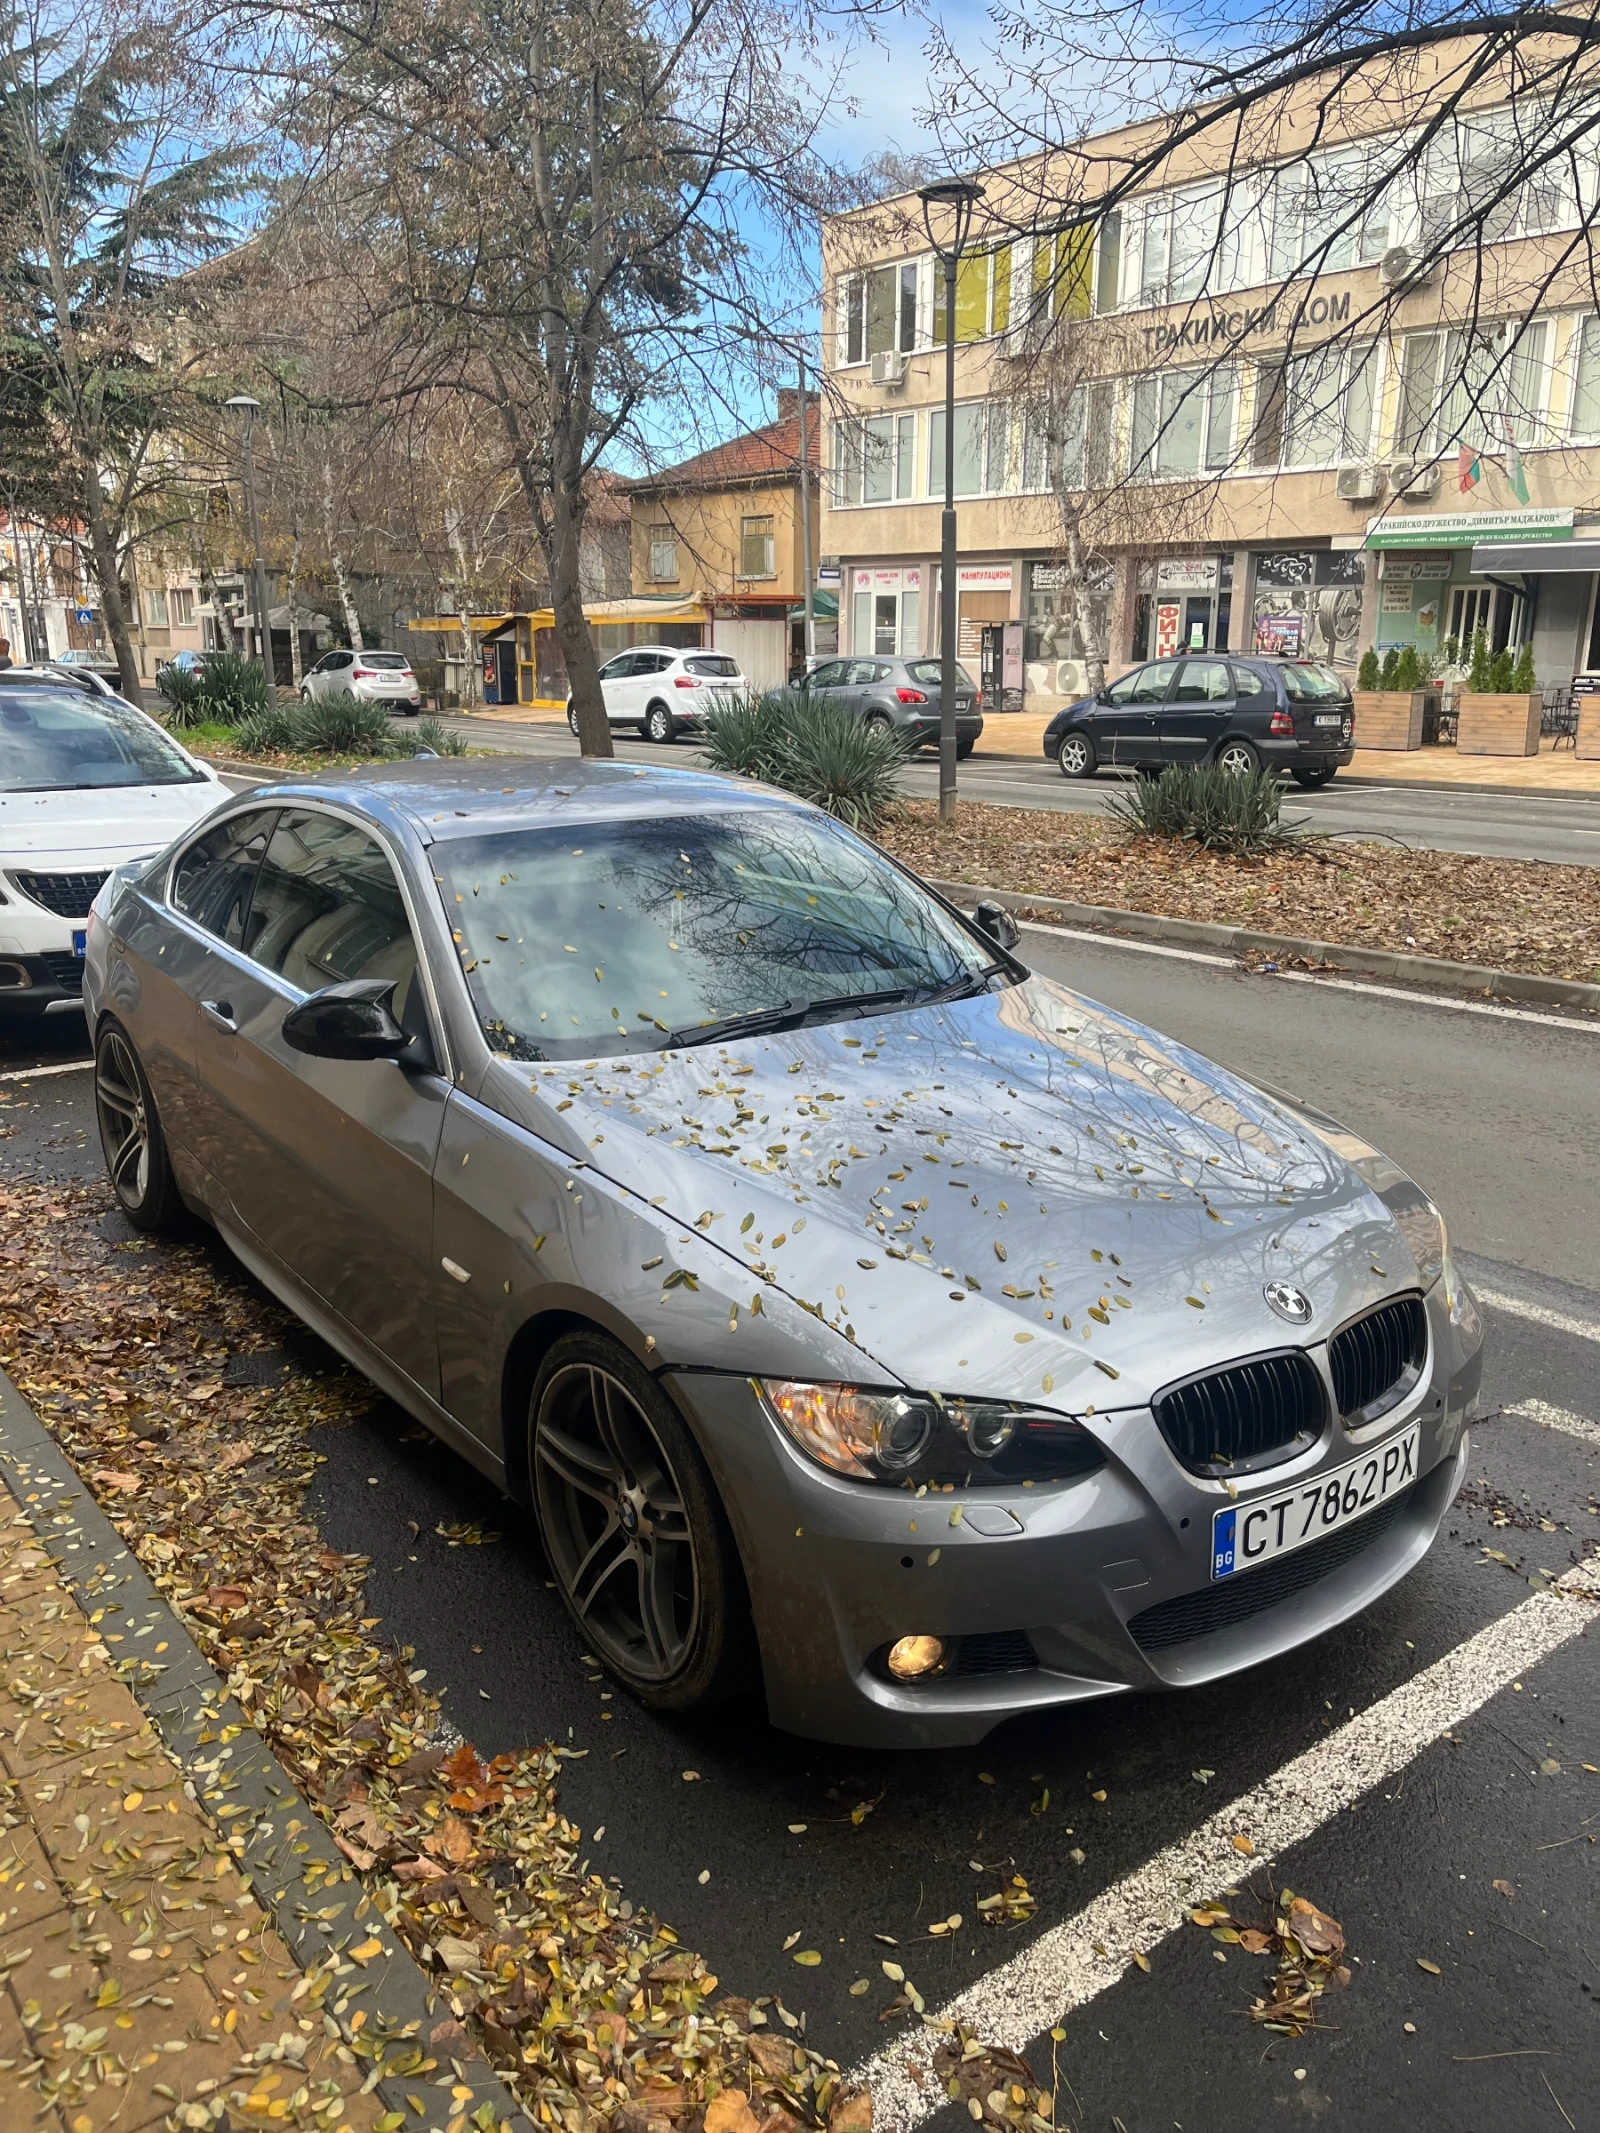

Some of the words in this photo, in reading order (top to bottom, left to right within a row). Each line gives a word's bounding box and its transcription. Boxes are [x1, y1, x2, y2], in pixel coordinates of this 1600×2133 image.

[1142, 304, 1276, 350] ТРАКИЙСКИ
[1289, 291, 1351, 330] ДОМ
[1380, 520, 1420, 530] ТРАКИЙСКО
[1422, 518, 1466, 529] ДРУЖЕСТВО
[1215, 1550, 1233, 1568] BG
